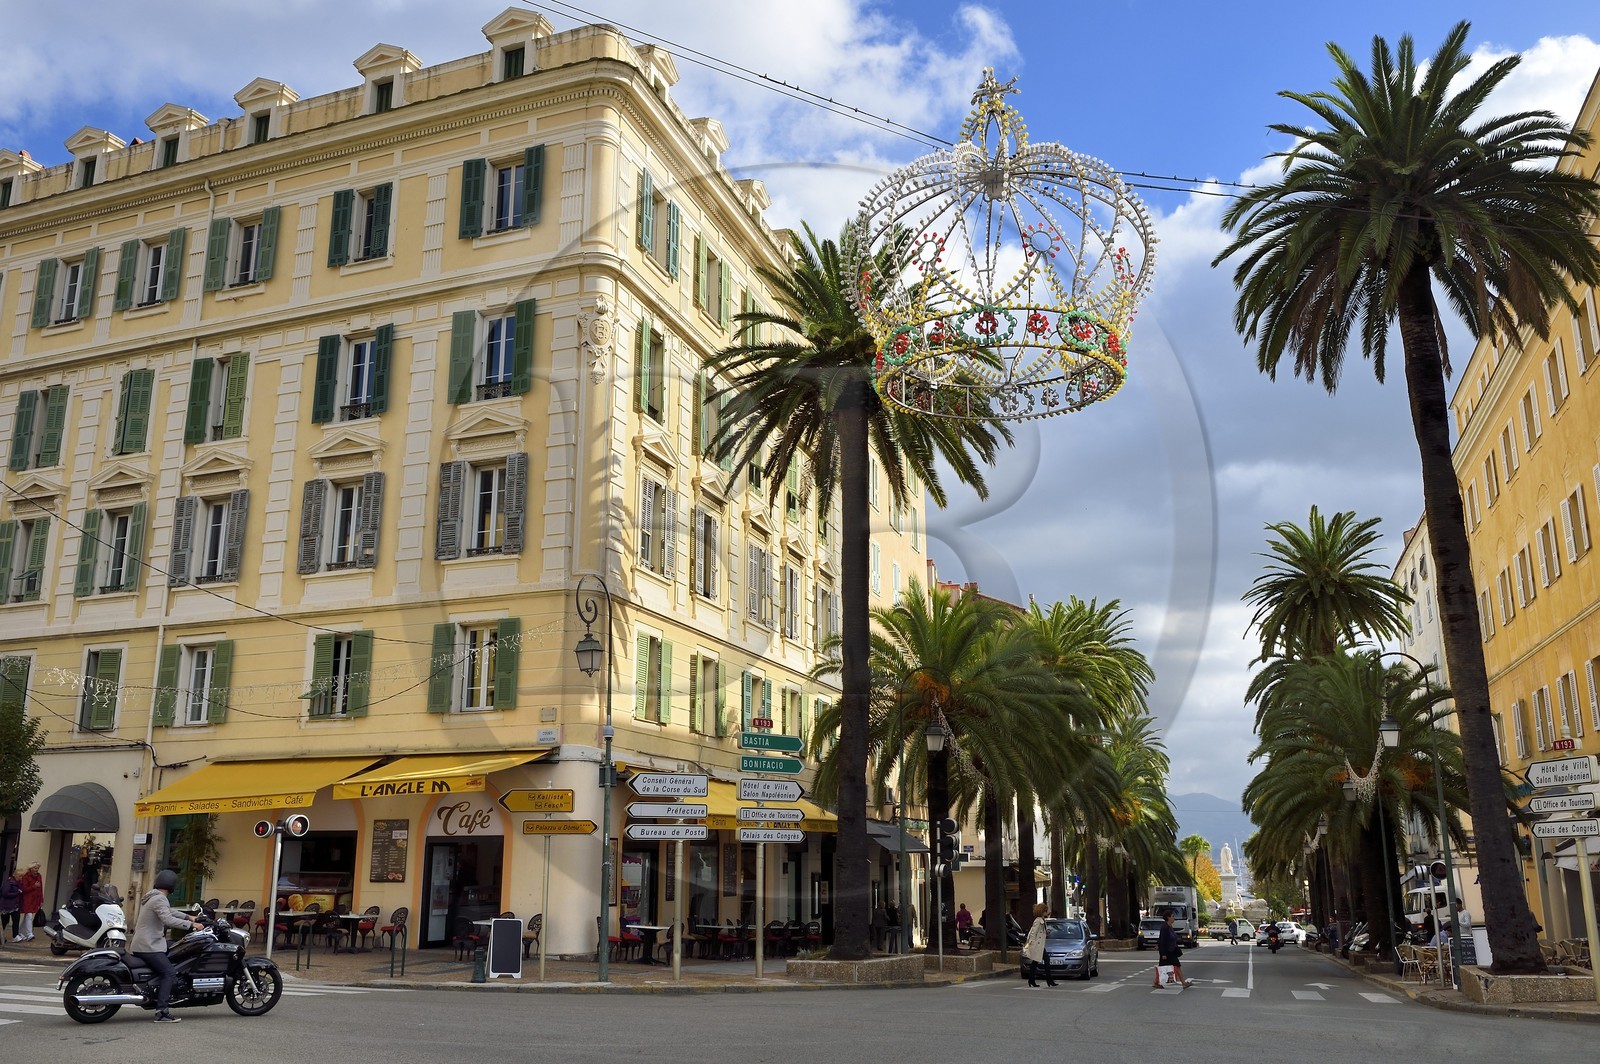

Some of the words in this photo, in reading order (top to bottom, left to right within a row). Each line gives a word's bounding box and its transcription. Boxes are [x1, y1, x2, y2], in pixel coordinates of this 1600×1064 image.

[744, 737, 770, 746] BASTIA
[744, 760, 784, 770] BONIFACIO
[1541, 764, 1557, 773] Hôtel
[1573, 761, 1588, 770] Ville
[1554, 772, 1590, 783] Napoléonien
[360, 781, 425, 797] L'ANGLE
[431, 780, 451, 792] M
[154, 804, 177, 813] Panini
[188, 802, 219, 810] Salades
[232, 799, 273, 808] Sandwichs
[285, 795, 304, 805] Café
[1543, 801, 1558, 809] Office
[1568, 798, 1592, 807] Tourisme
[437, 801, 494, 835] Café
[1538, 826, 1555, 834] Palais
[1558, 825, 1568, 833] des
[1572, 824, 1596, 834] Congrès
[776, 832, 799, 840] Congrès
